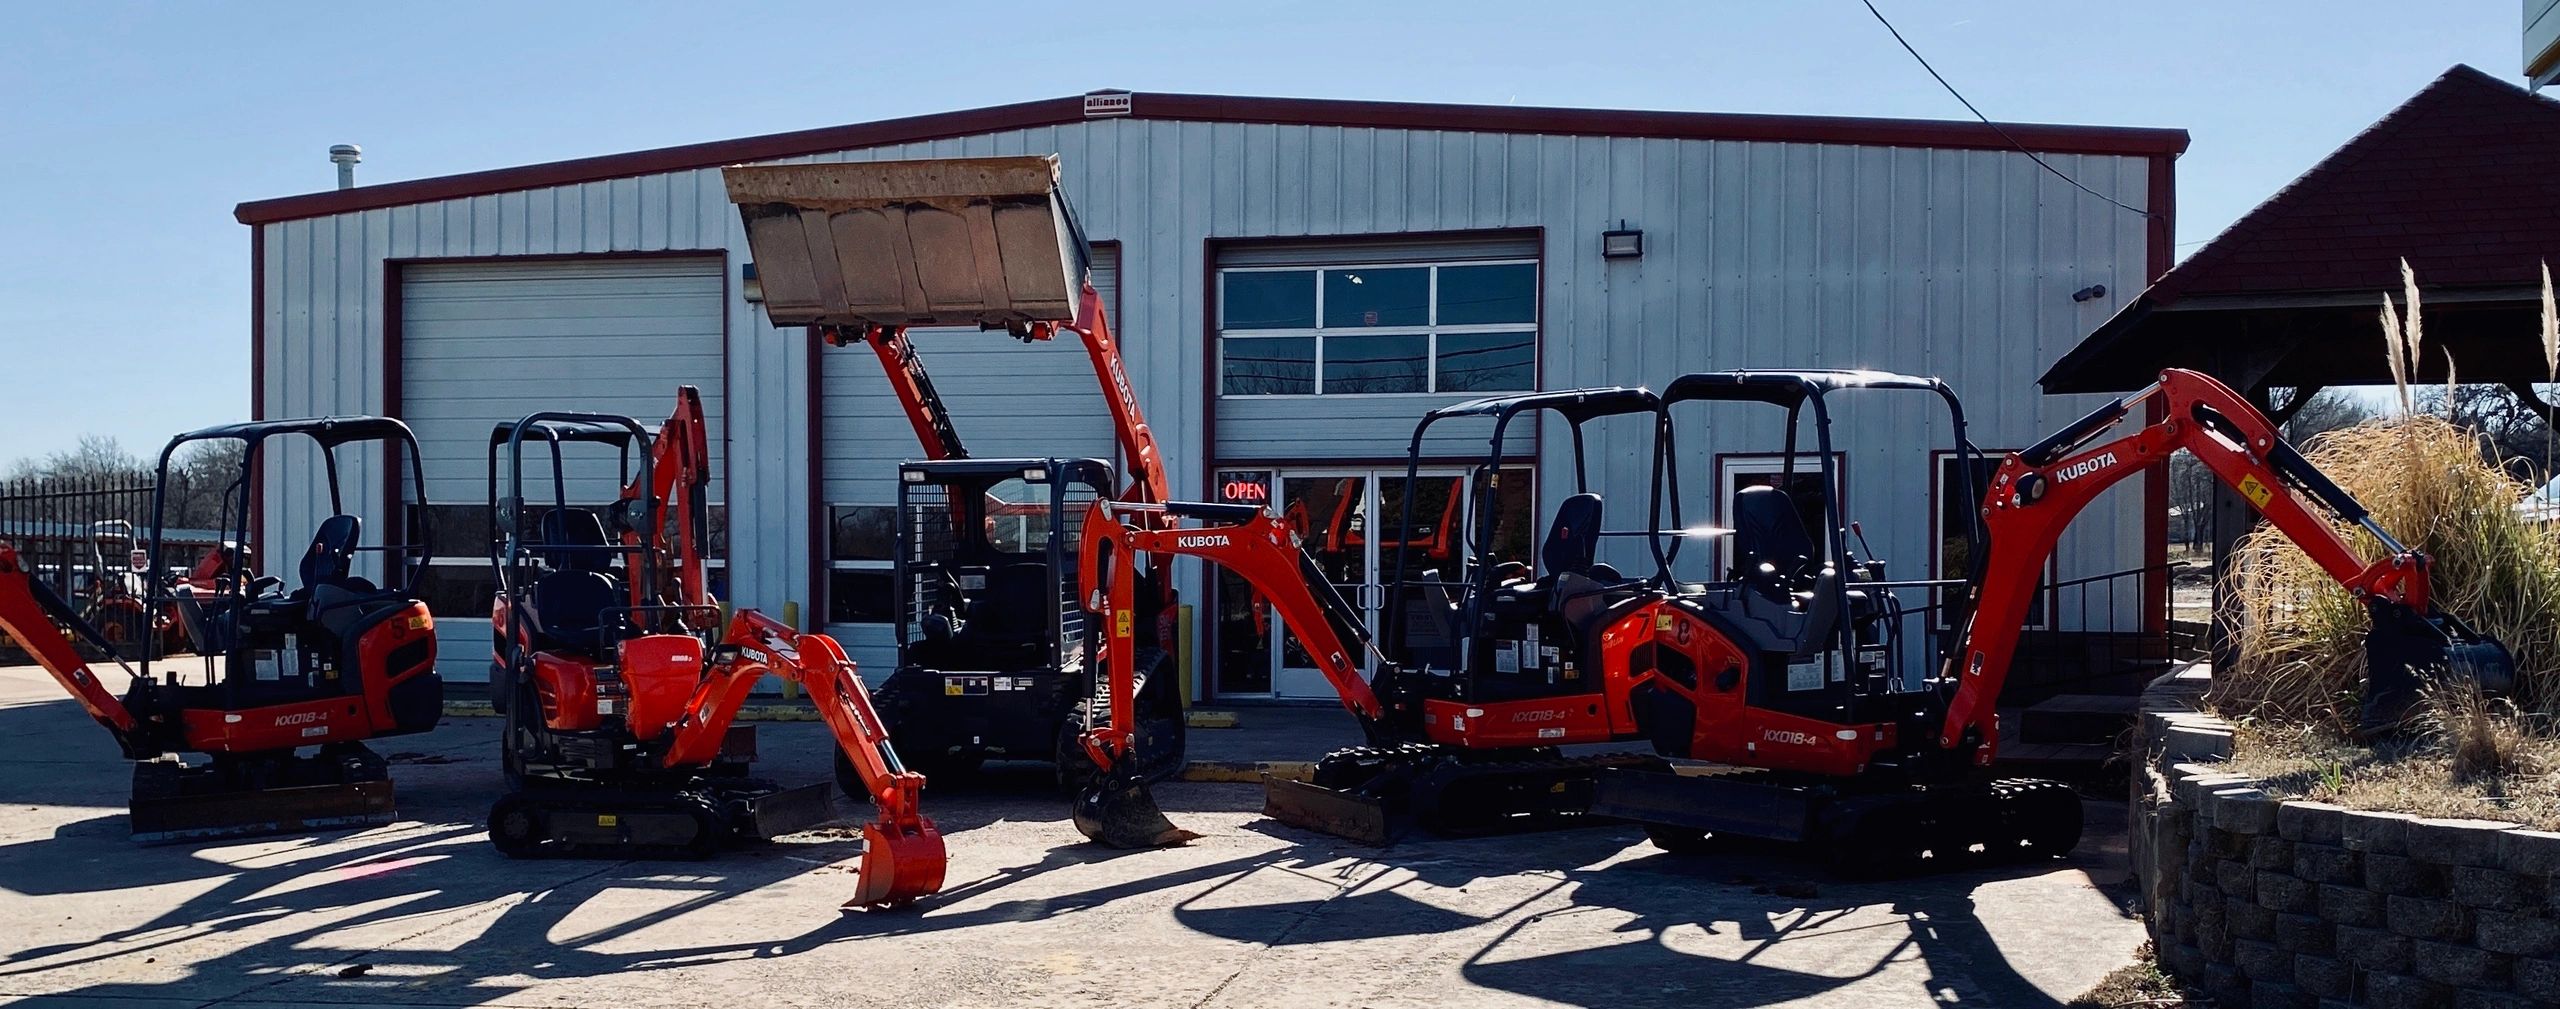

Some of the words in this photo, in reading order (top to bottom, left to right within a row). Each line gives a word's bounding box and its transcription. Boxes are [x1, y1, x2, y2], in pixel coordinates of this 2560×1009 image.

[1110, 352, 1135, 422] KUBOTA
[2056, 452, 2117, 483] KUBOTA
[1225, 482, 1266, 500] OPEN
[1178, 535, 1230, 548] KUBOTA
[741, 646, 768, 665] KUBOTA
[275, 711, 328, 727] KX018-4
[1512, 710, 1566, 723] KX018-4
[1764, 729, 1817, 746] KX018-4
